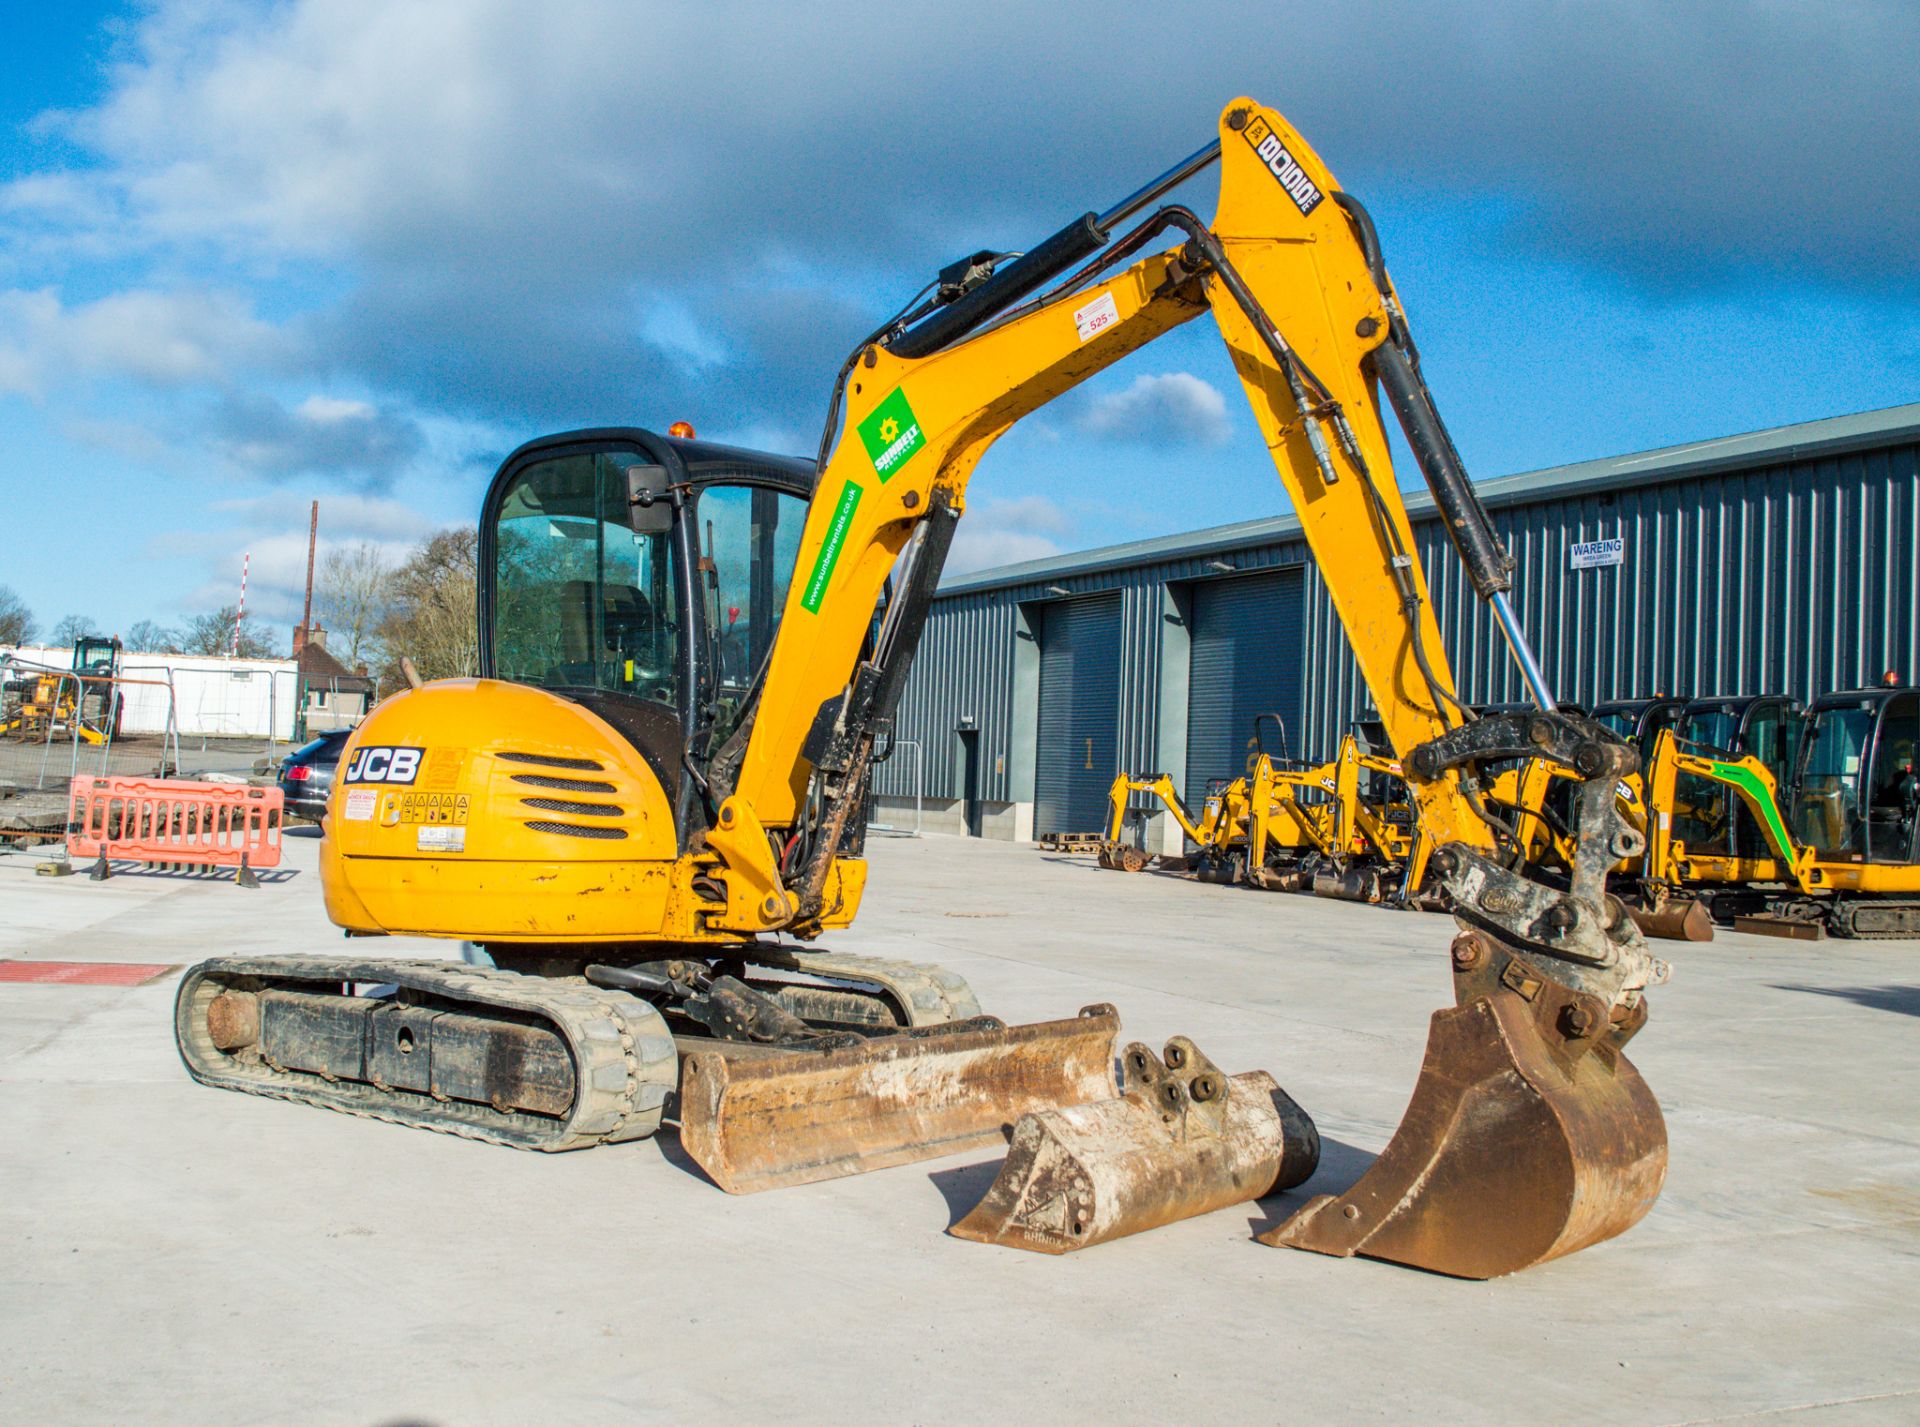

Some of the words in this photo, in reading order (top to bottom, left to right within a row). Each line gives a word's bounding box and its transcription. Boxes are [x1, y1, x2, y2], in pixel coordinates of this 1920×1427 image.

[1257, 134, 1316, 206] 8055
[1300, 191, 1320, 212] RTS
[1090, 313, 1108, 331] 525
[874, 423, 920, 472] SUNBELT
[808, 488, 856, 606] www.sunbeltrentals.co.uk
[1573, 540, 1622, 556] WAREING
[346, 750, 421, 782] JCB
